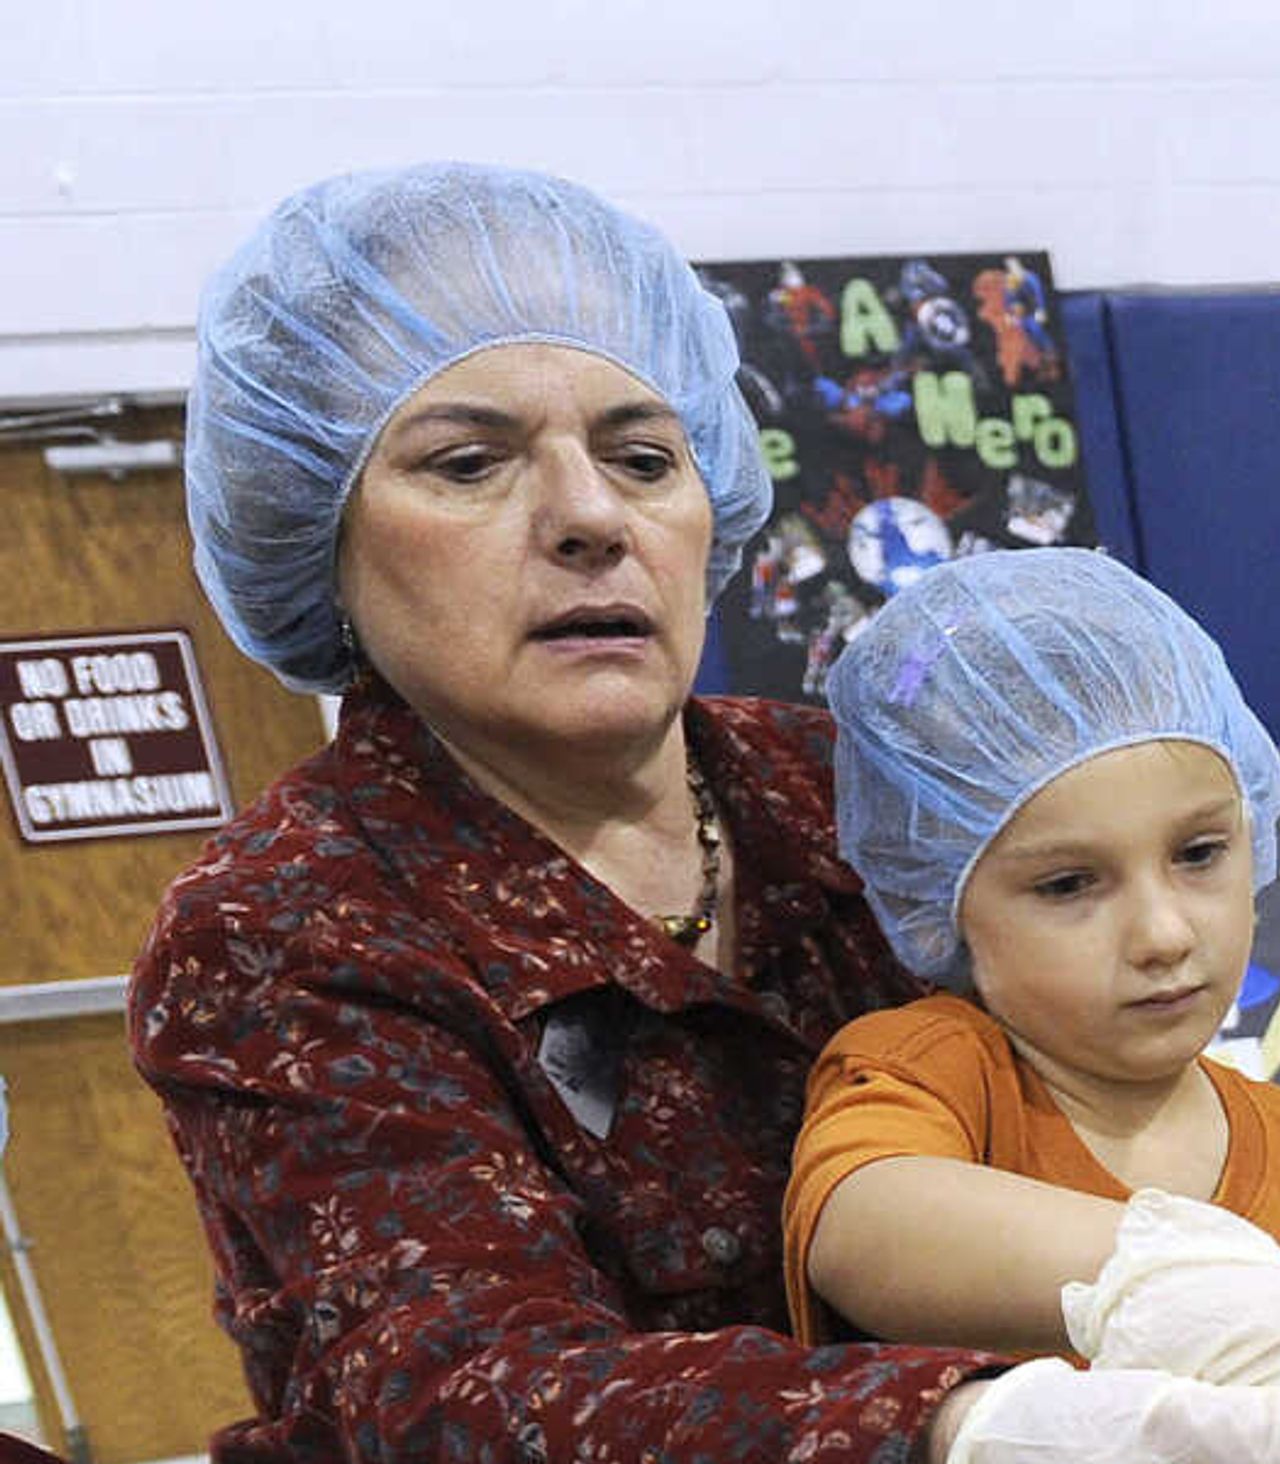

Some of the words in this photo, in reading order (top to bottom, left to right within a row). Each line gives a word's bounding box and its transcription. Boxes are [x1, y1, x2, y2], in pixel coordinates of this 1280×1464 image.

[839, 278, 899, 357] A
[912, 370, 1077, 468] Hero
[16, 658, 69, 698] NO
[71, 651, 161, 695] FOOD
[10, 701, 62, 741] OR
[63, 691, 189, 738] DRINKS
[89, 737, 132, 777] IN
[24, 771, 216, 824] GYMNASIUM
